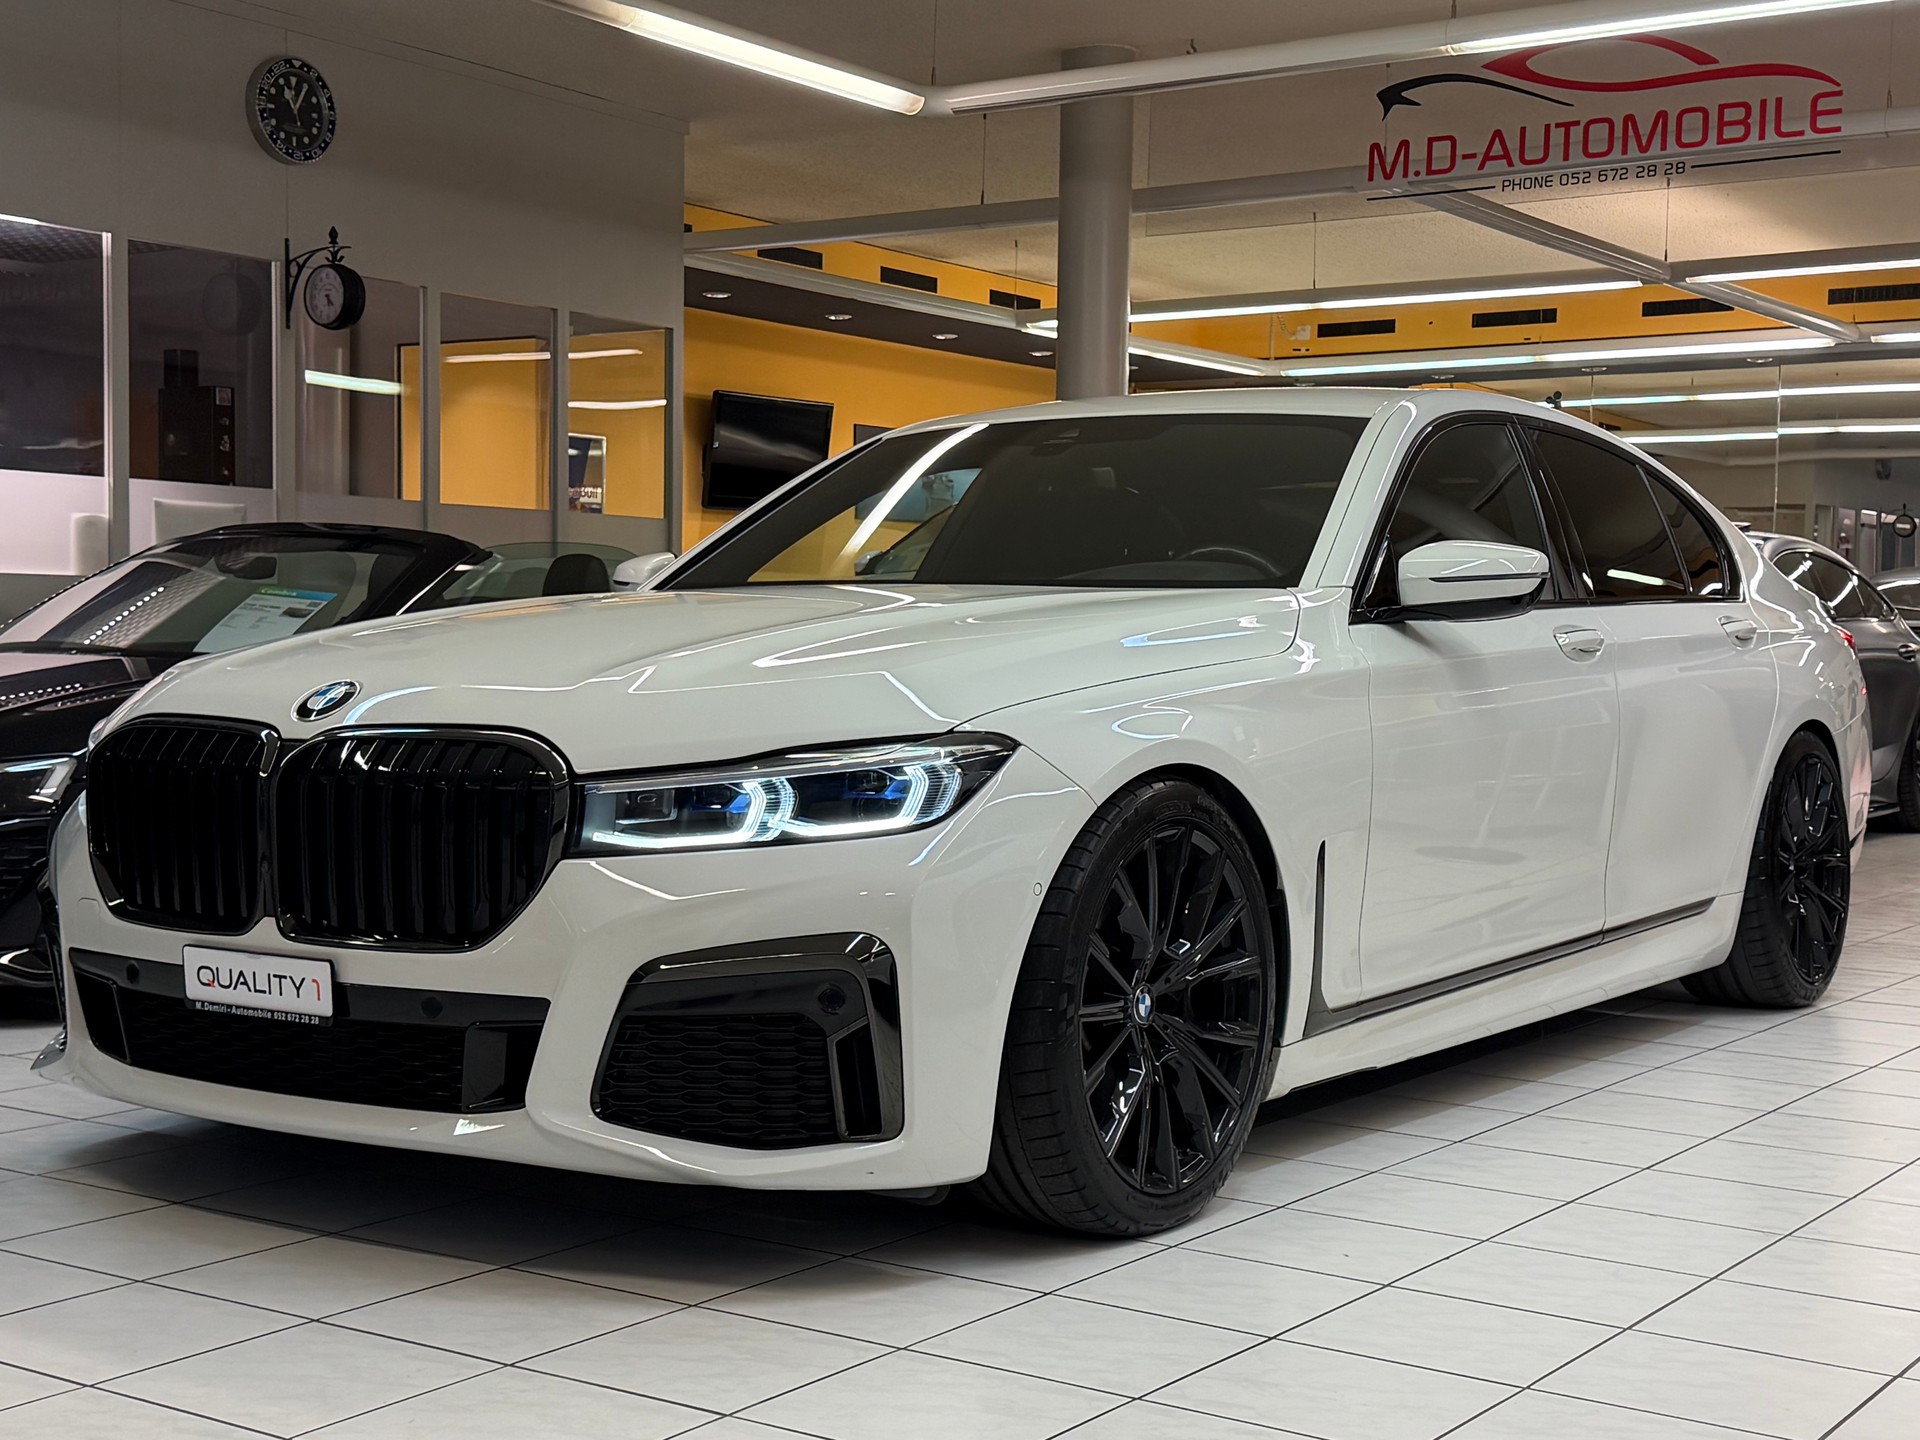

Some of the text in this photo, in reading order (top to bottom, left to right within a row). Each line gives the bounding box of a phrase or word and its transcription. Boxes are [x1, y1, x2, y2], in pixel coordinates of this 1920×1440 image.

[271, 60, 287, 74] 22
[261, 73, 272, 89] 20
[1367, 90, 1843, 182] M.D-AUTOMOBILE
[1502, 161, 1686, 192] PHONE 052 672 28 28
[197, 965, 321, 1001] QUALITY 1
[273, 1011, 286, 1021] 052
[287, 1013, 300, 1022] 672
[301, 1015, 310, 1024] 28
[310, 1016, 320, 1025] 28
